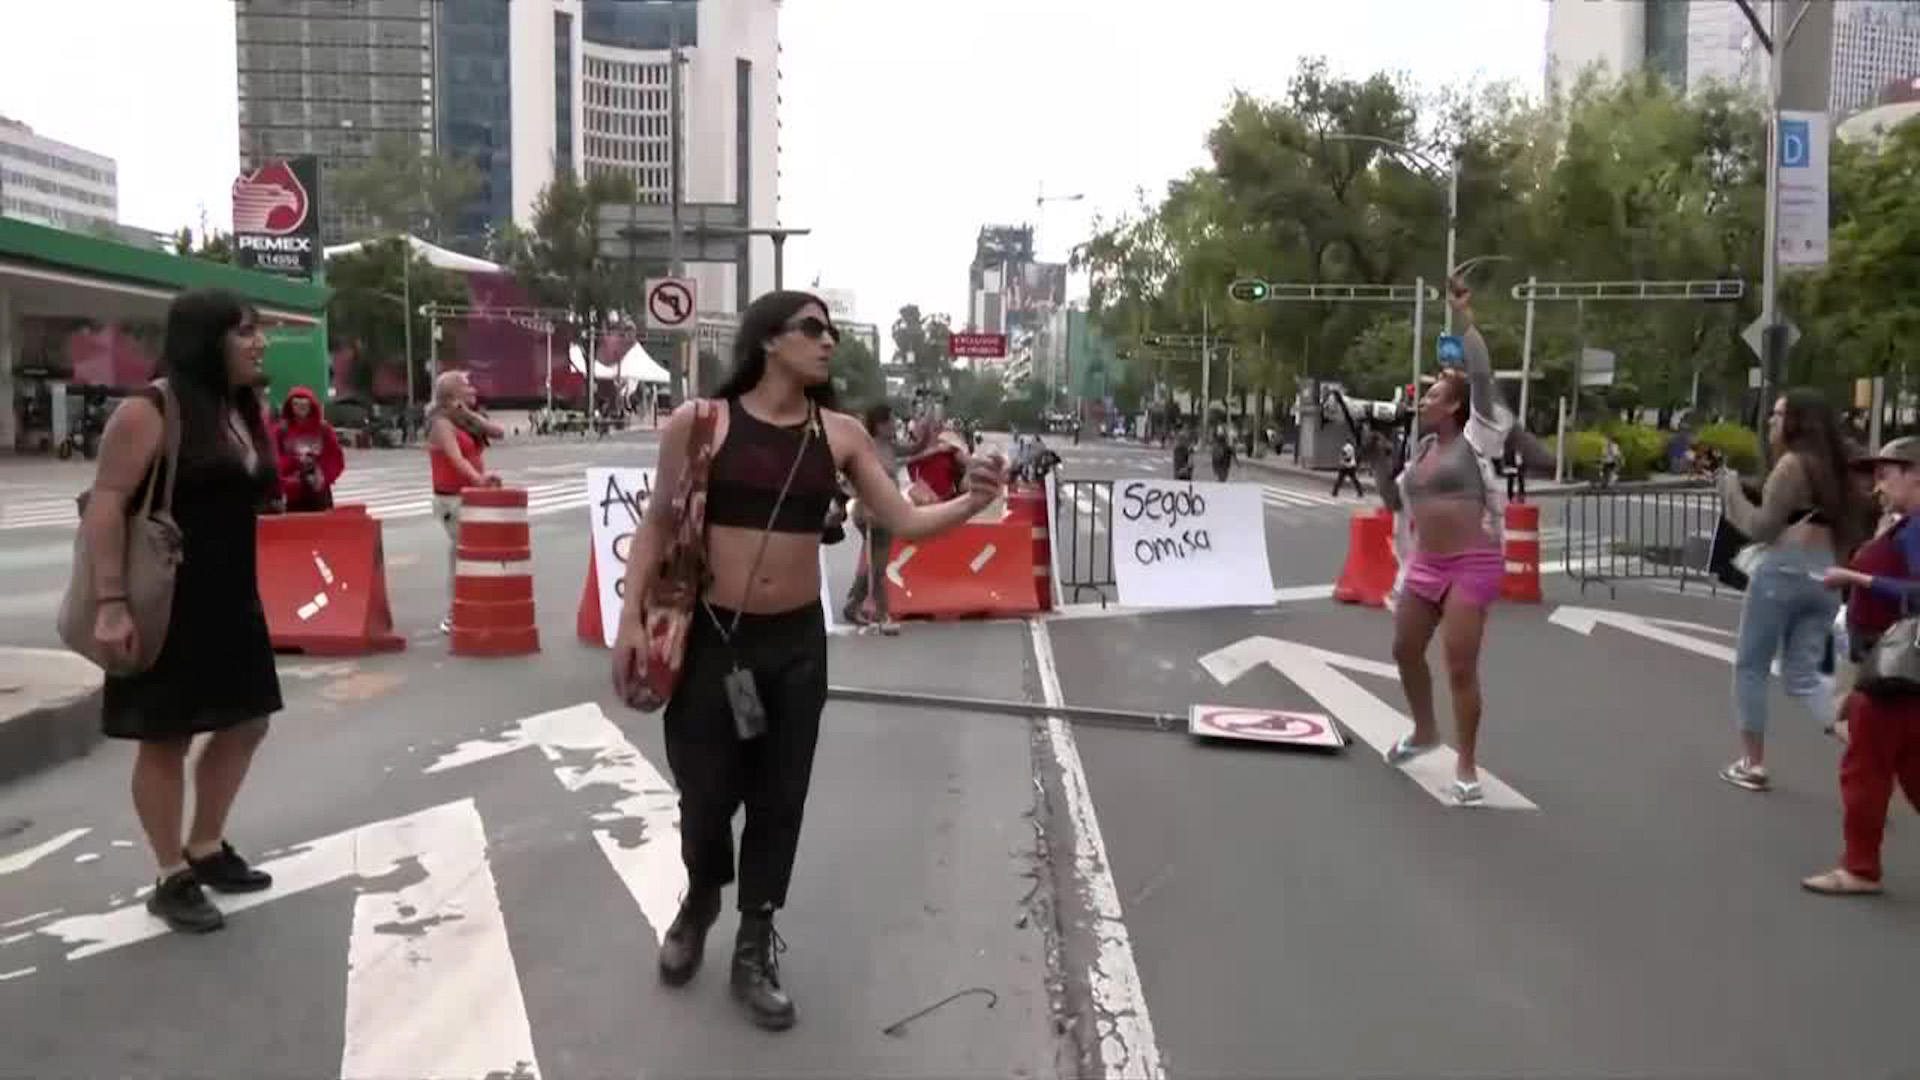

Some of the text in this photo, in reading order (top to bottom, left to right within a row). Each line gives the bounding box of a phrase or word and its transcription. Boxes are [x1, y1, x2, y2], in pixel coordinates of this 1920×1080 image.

[1784, 133, 1803, 164] D
[239, 236, 311, 252] PEMEX
[1123, 483, 1205, 528] Segob
[1135, 530, 1211, 565] omisa
